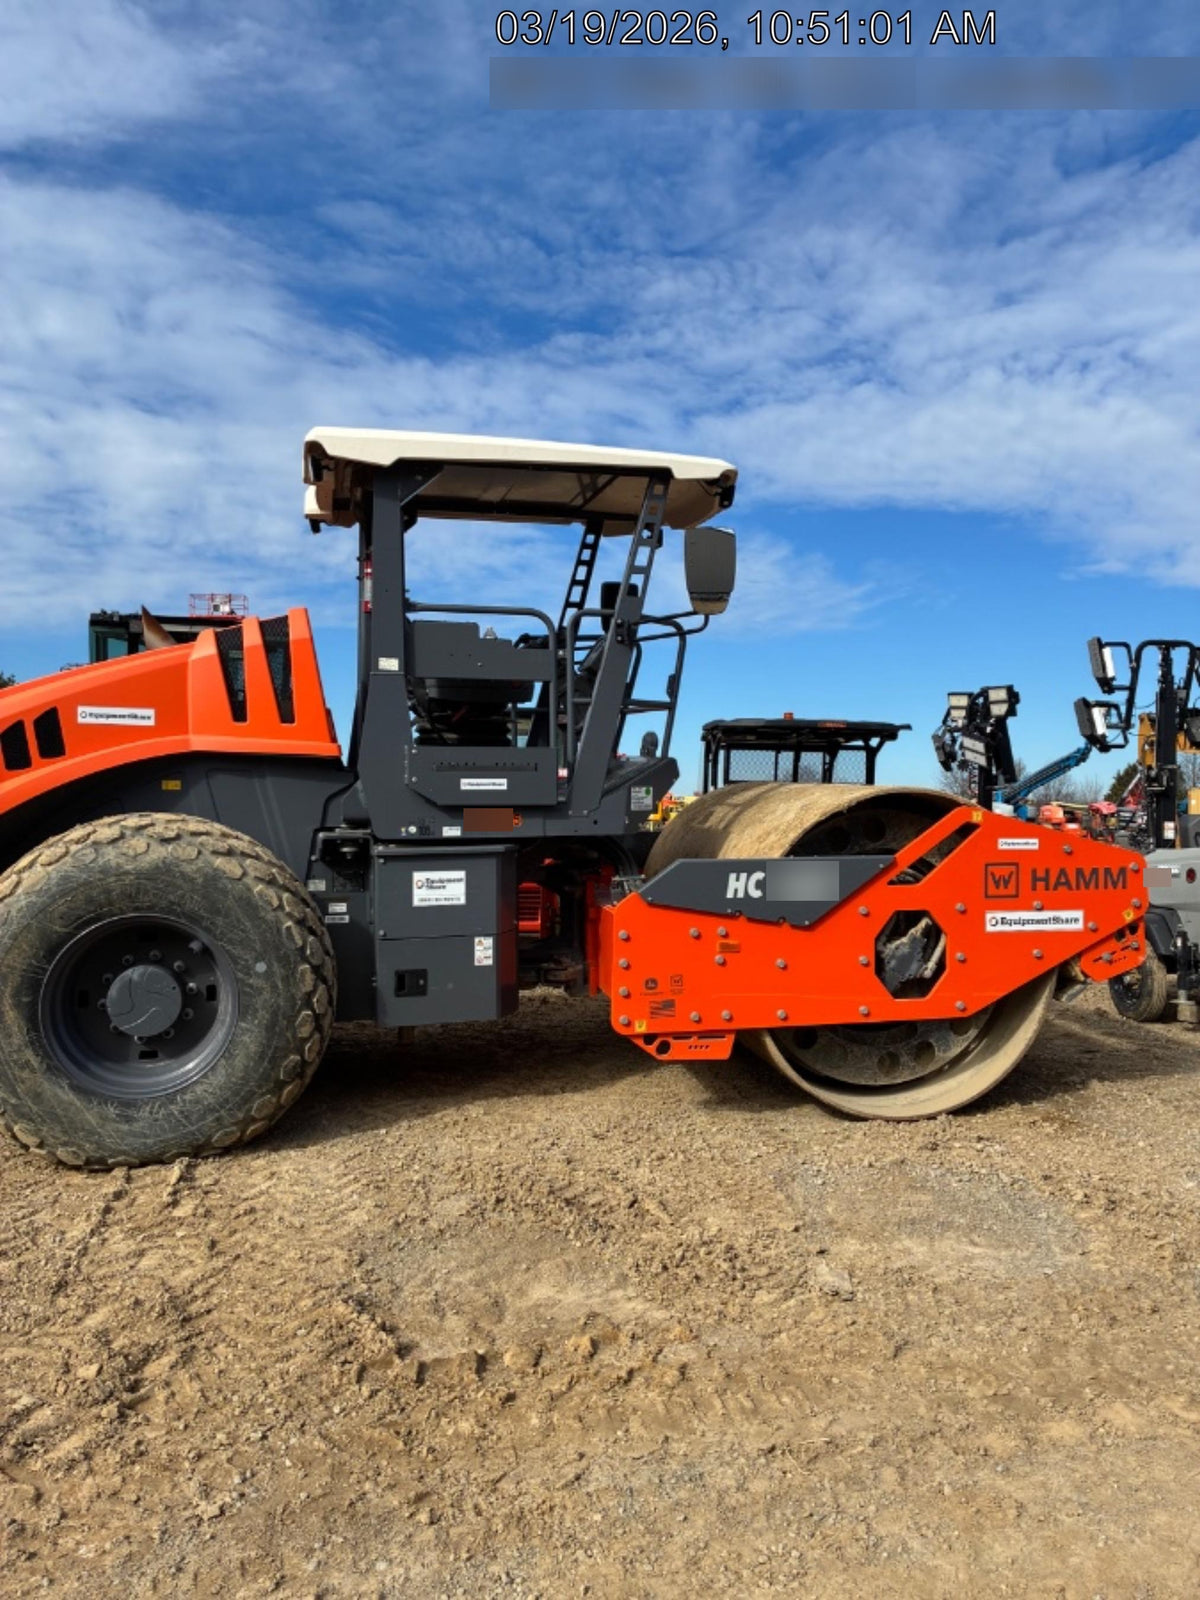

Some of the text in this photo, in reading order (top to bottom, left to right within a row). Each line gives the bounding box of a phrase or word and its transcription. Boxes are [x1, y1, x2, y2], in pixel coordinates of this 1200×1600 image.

[726, 871, 766, 898] HC
[1031, 867, 1128, 891] HAMM
[1000, 915, 1080, 927] EquipmentShare
